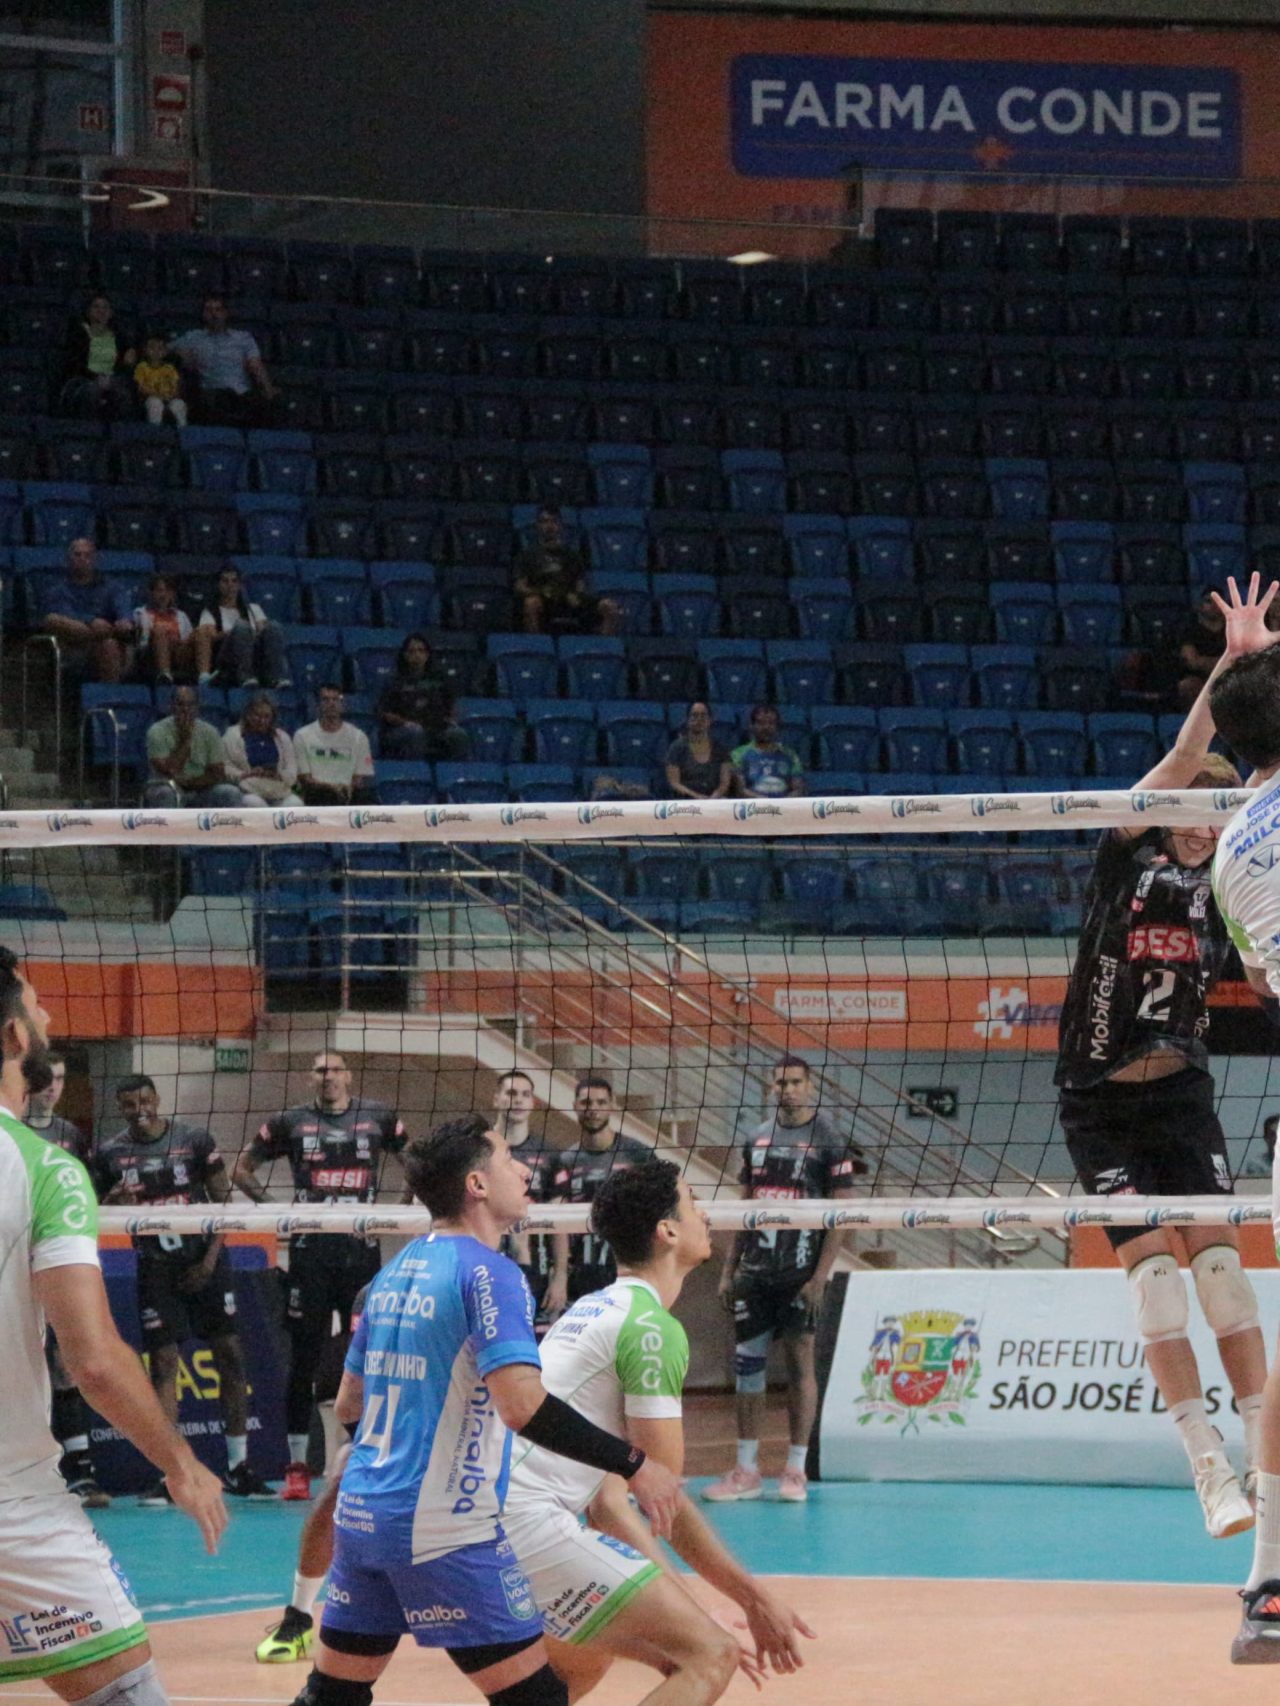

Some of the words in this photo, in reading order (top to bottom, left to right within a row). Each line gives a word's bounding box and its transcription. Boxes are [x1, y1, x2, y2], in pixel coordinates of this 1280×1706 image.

[750, 78, 976, 132] FARMA
[997, 86, 1222, 138] CONDE
[780, 995, 836, 1009] FARMA
[843, 996, 900, 1010] CONDE
[1089, 954, 1119, 1060] Mobifácil
[1136, 968, 1177, 1021] 2
[42, 1146, 89, 1229] vero
[315, 1169, 365, 1189] SESI
[473, 1264, 500, 1340] minalba
[634, 1310, 664, 1390] vero
[997, 1340, 1147, 1368] PREFEITU
[988, 1375, 1057, 1410] SÃO
[1062, 1377, 1144, 1413] JOSÉ
[548, 1599, 563, 1612] Lei
[562, 1587, 575, 1600] de
[30, 1609, 50, 1622] Lei
[51, 1605, 68, 1618] de
[35, 1610, 94, 1637] Incentivo
[403, 1605, 467, 1624] inalba
[568, 1603, 593, 1627] Fiscal
[40, 1629, 76, 1651] Fiscal
